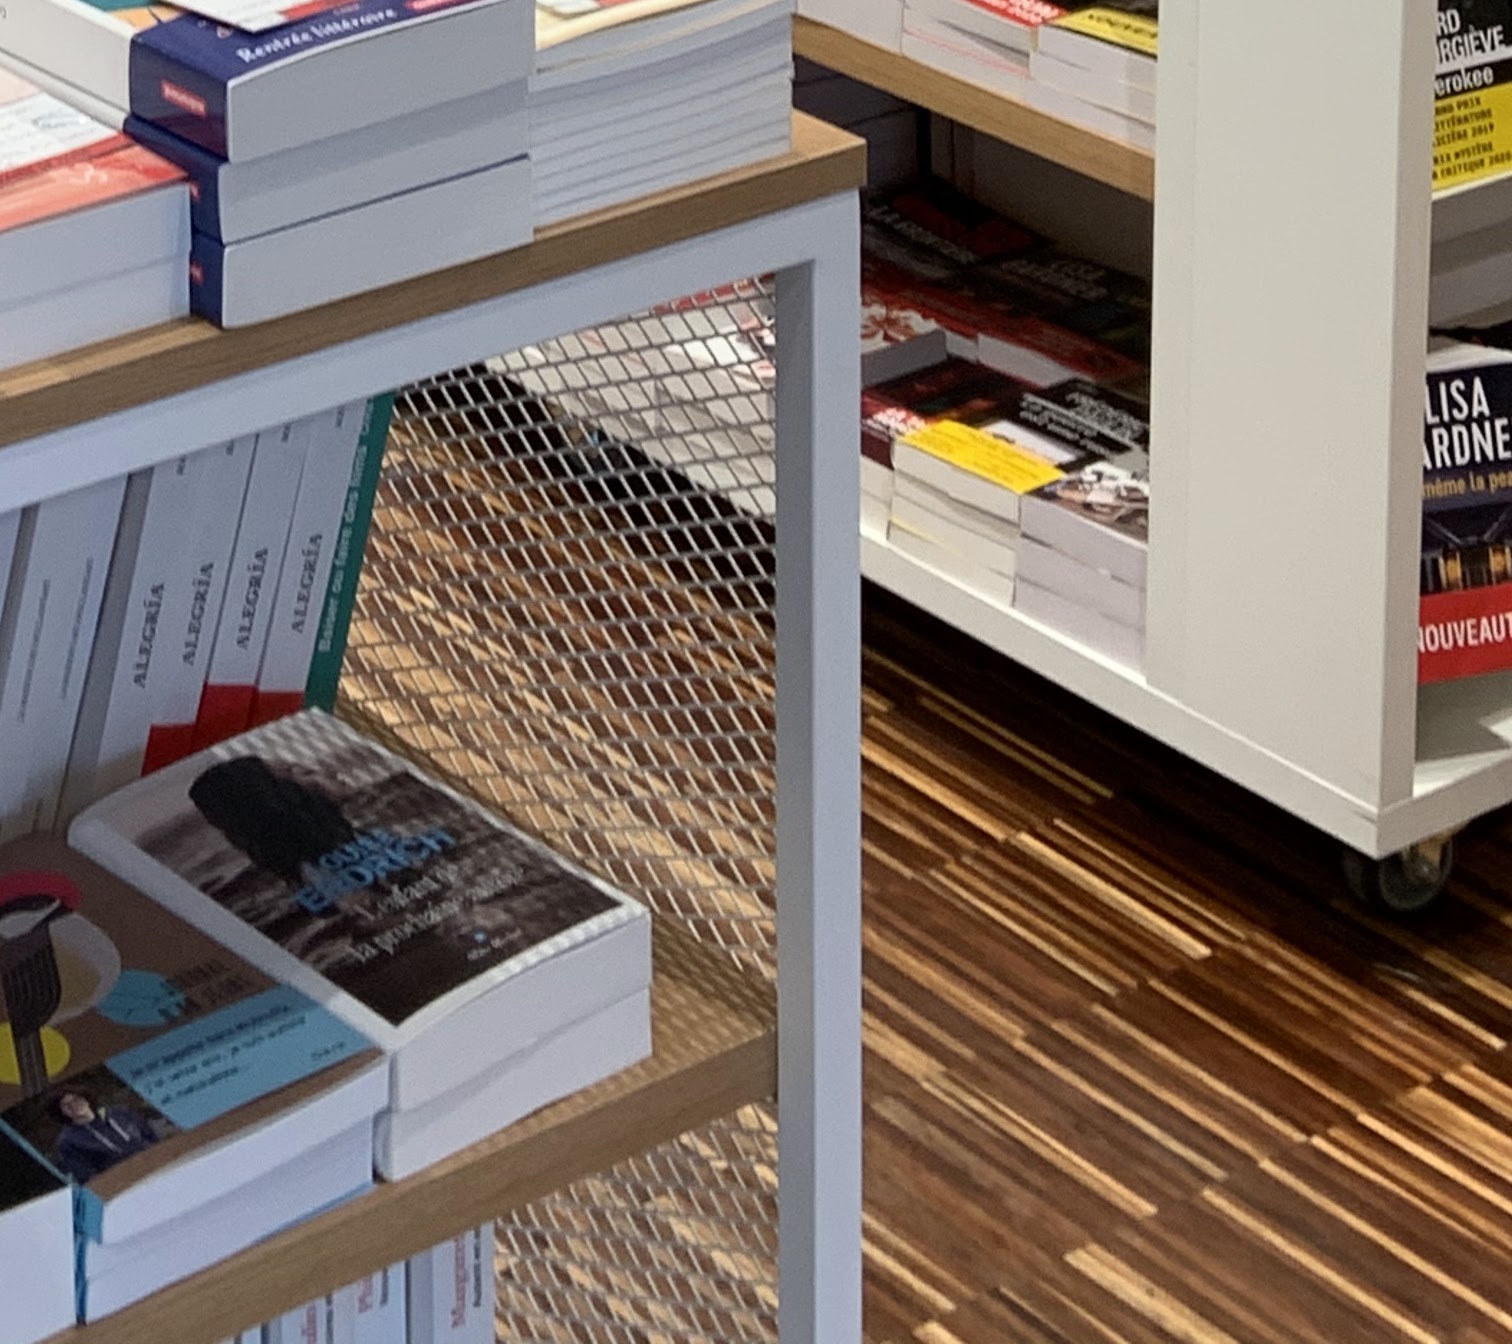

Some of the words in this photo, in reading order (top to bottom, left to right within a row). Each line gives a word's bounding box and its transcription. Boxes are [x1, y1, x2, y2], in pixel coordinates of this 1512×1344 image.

[1456, 96, 1482, 112] PRIX
[1425, 375, 1491, 426] LISA
[1469, 470, 1485, 492] la
[183, 561, 214, 666] ALEGRÍA
[236, 547, 268, 651] ALEGRÍA
[291, 532, 323, 634] ALEGRÍA
[134, 581, 165, 688] ALEGRÍA
